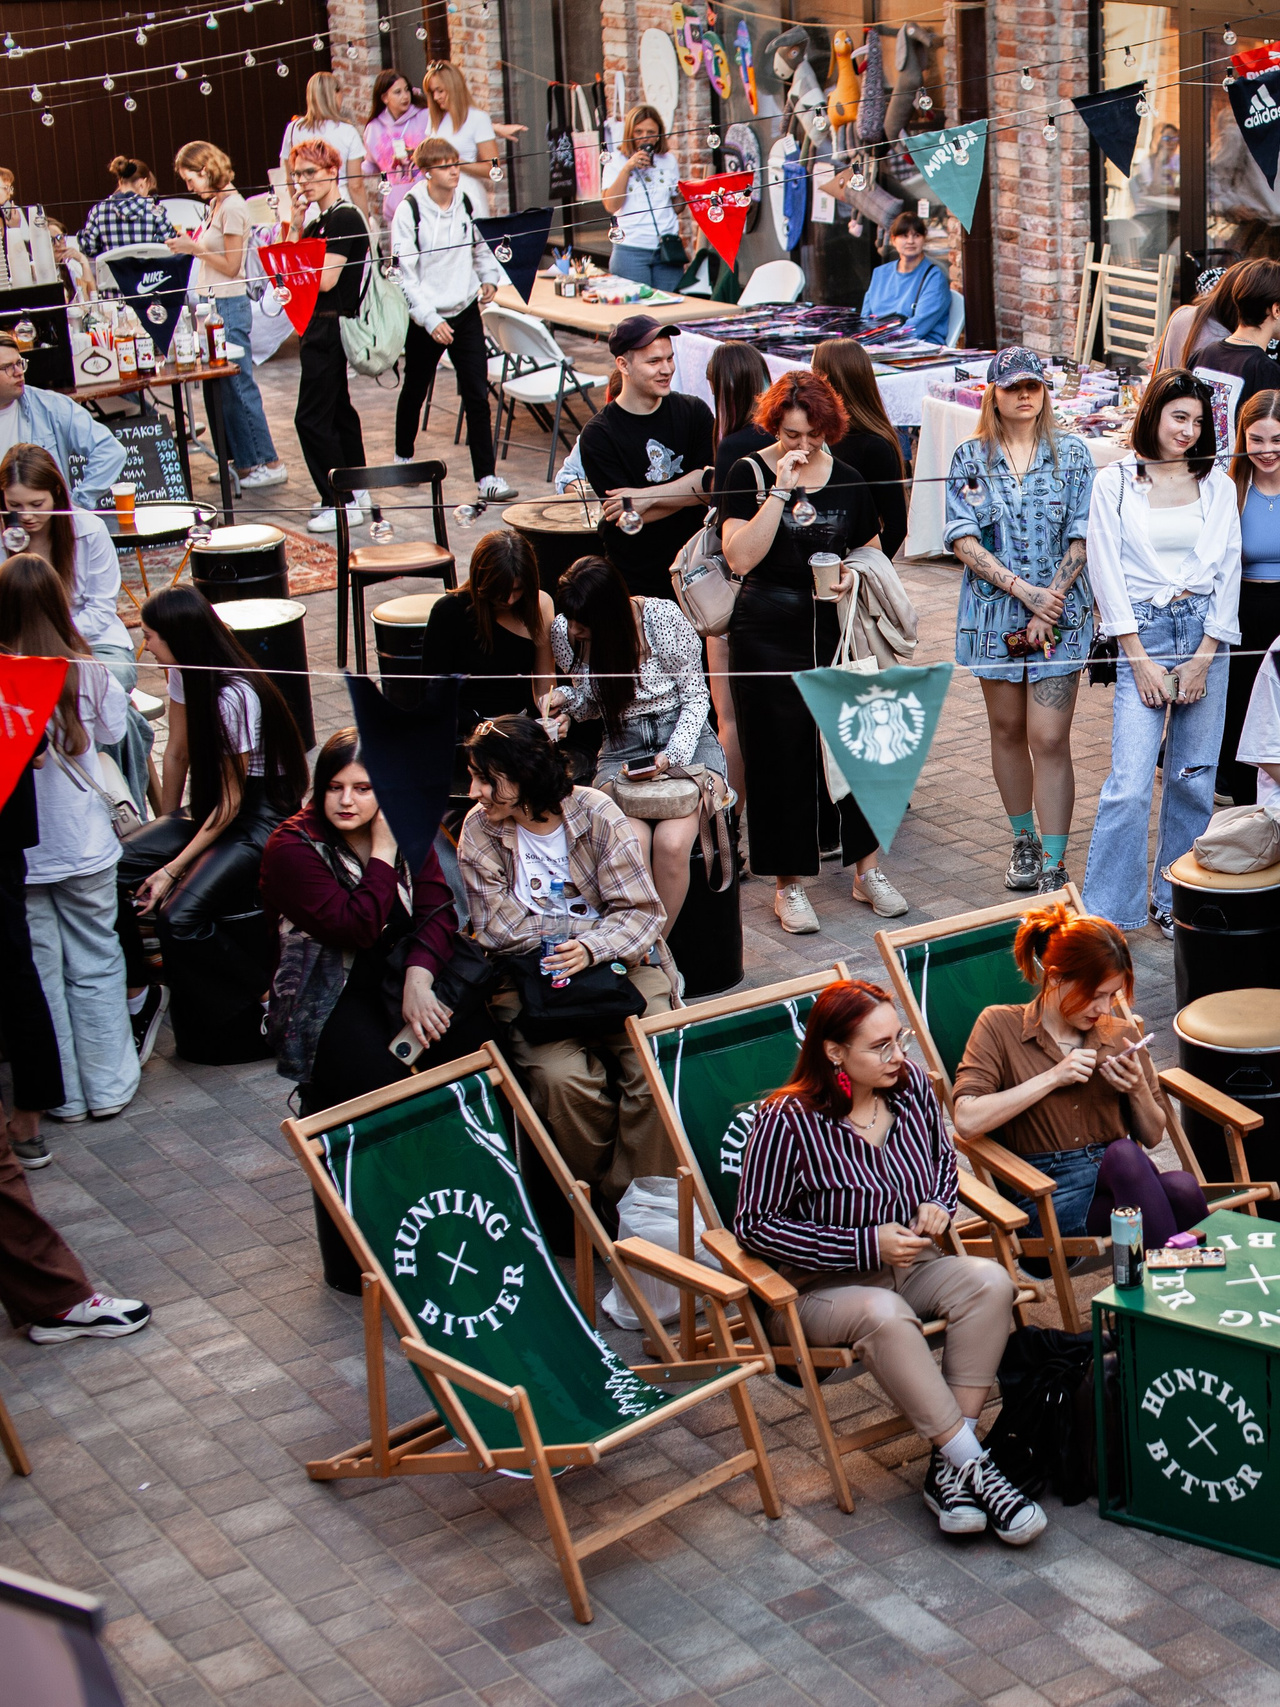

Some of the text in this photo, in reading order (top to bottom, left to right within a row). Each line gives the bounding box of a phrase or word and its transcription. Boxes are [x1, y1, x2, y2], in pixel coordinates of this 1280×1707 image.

[142, 270, 164, 284] NIKE
[155, 439, 174, 452] 390
[159, 450, 177, 463] 390
[161, 462, 181, 475] 360
[164, 475, 182, 487] 390
[168, 485, 185, 497] 330
[395, 1188, 512, 1277] HUNTING
[418, 1263, 525, 1340] BITTER
[1140, 1367, 1265, 1447] HUNTING
[1146, 1438, 1263, 1503] BITTER
